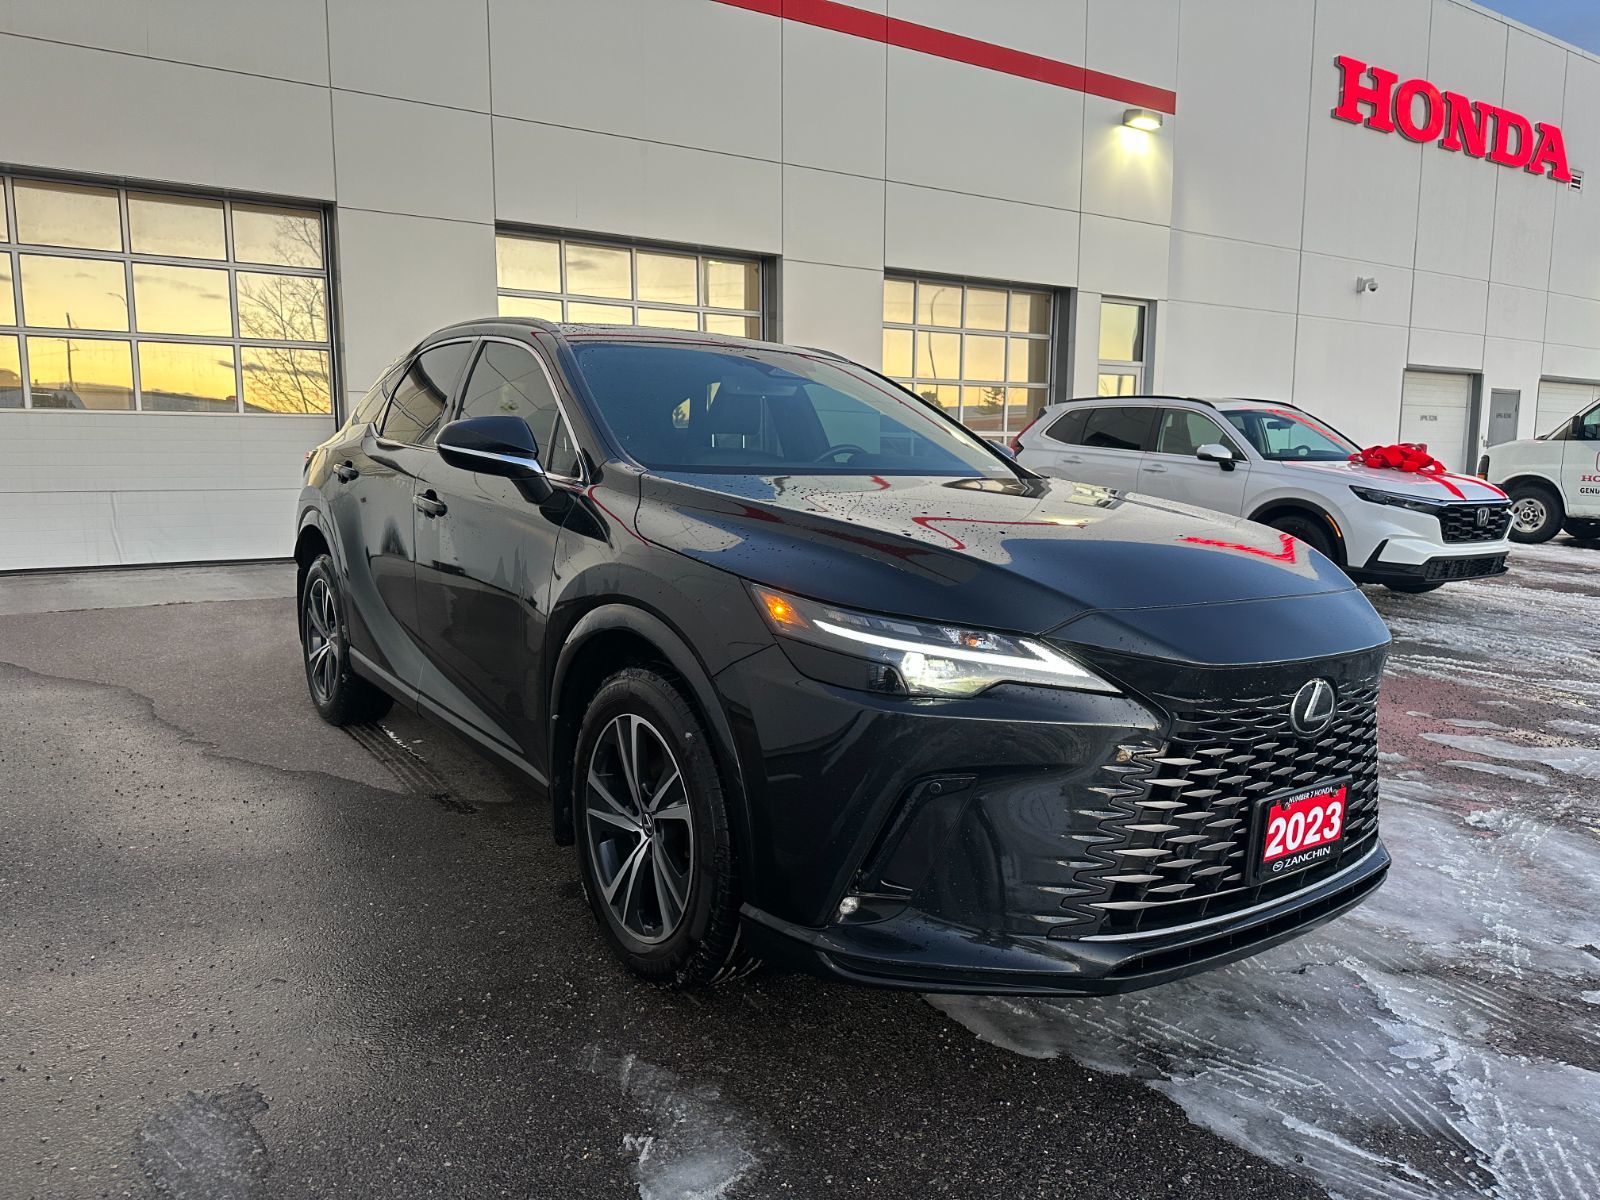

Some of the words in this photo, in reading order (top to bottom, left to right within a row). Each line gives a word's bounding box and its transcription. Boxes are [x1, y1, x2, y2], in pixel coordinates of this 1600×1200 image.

[1331, 55, 1572, 183] HONDA
[1288, 792, 1310, 803] NUMBER
[1314, 786, 1333, 797] HONDA
[1264, 801, 1342, 858] 2023
[1284, 846, 1331, 868] ZANCHIN
